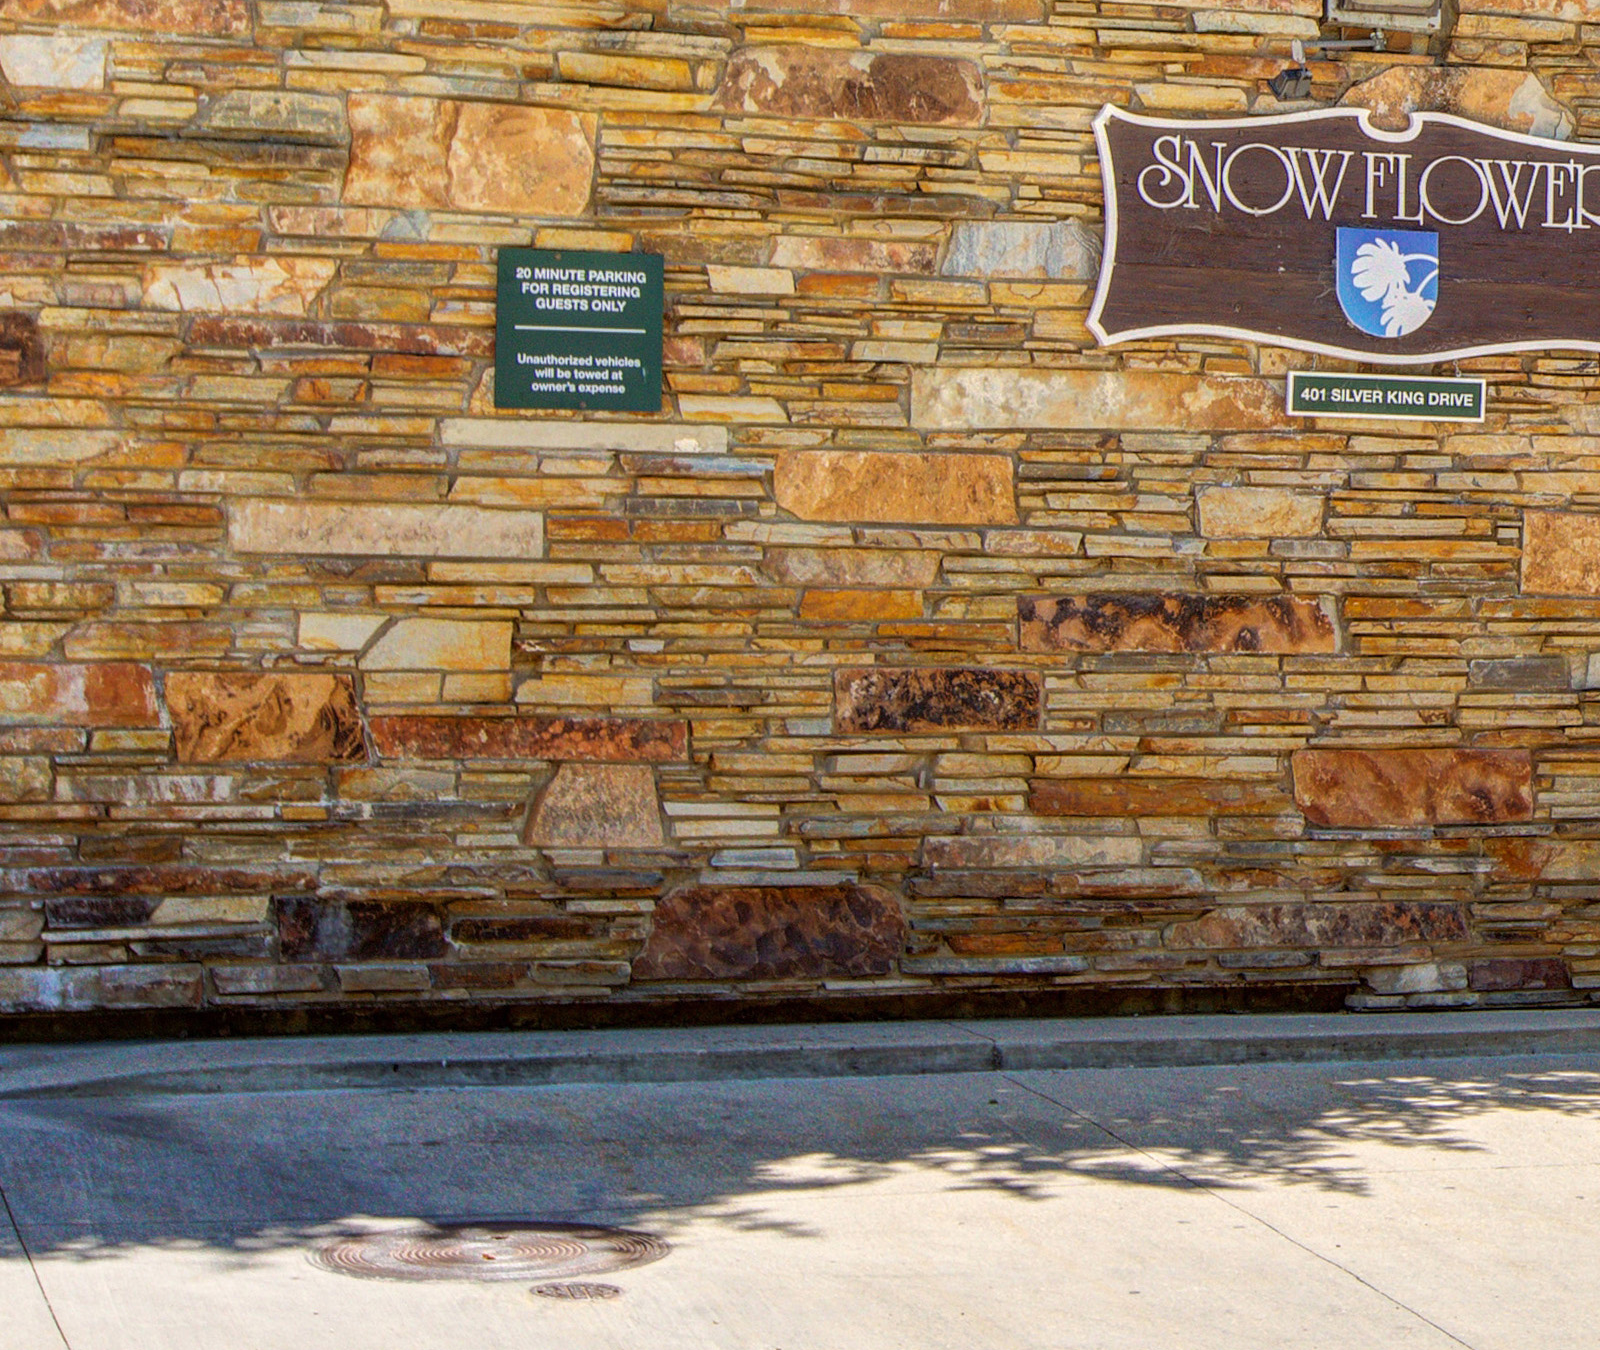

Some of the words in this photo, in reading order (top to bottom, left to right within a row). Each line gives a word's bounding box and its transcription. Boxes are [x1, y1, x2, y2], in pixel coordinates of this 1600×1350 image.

[516, 267, 531, 279] 20
[534, 268, 585, 281] MINUTE
[588, 270, 646, 283] PARKING
[521, 282, 549, 294] FOR
[552, 283, 641, 298] REGISTERING
[535, 298, 588, 311] GUESTS
[591, 300, 627, 312] ONLY
[516, 353, 592, 366] Unauthorized
[595, 356, 641, 368] vehicles
[534, 367, 554, 379] will
[557, 368, 571, 379] be
[573, 368, 609, 380] towed
[611, 369, 623, 380] at
[531, 381, 576, 392] owner's
[578, 383, 626, 394] expense
[1301, 388, 1326, 401] 401
[1330, 388, 1383, 404] SILVER
[1387, 391, 1424, 405] KING
[1428, 392, 1474, 407] DRIVE
